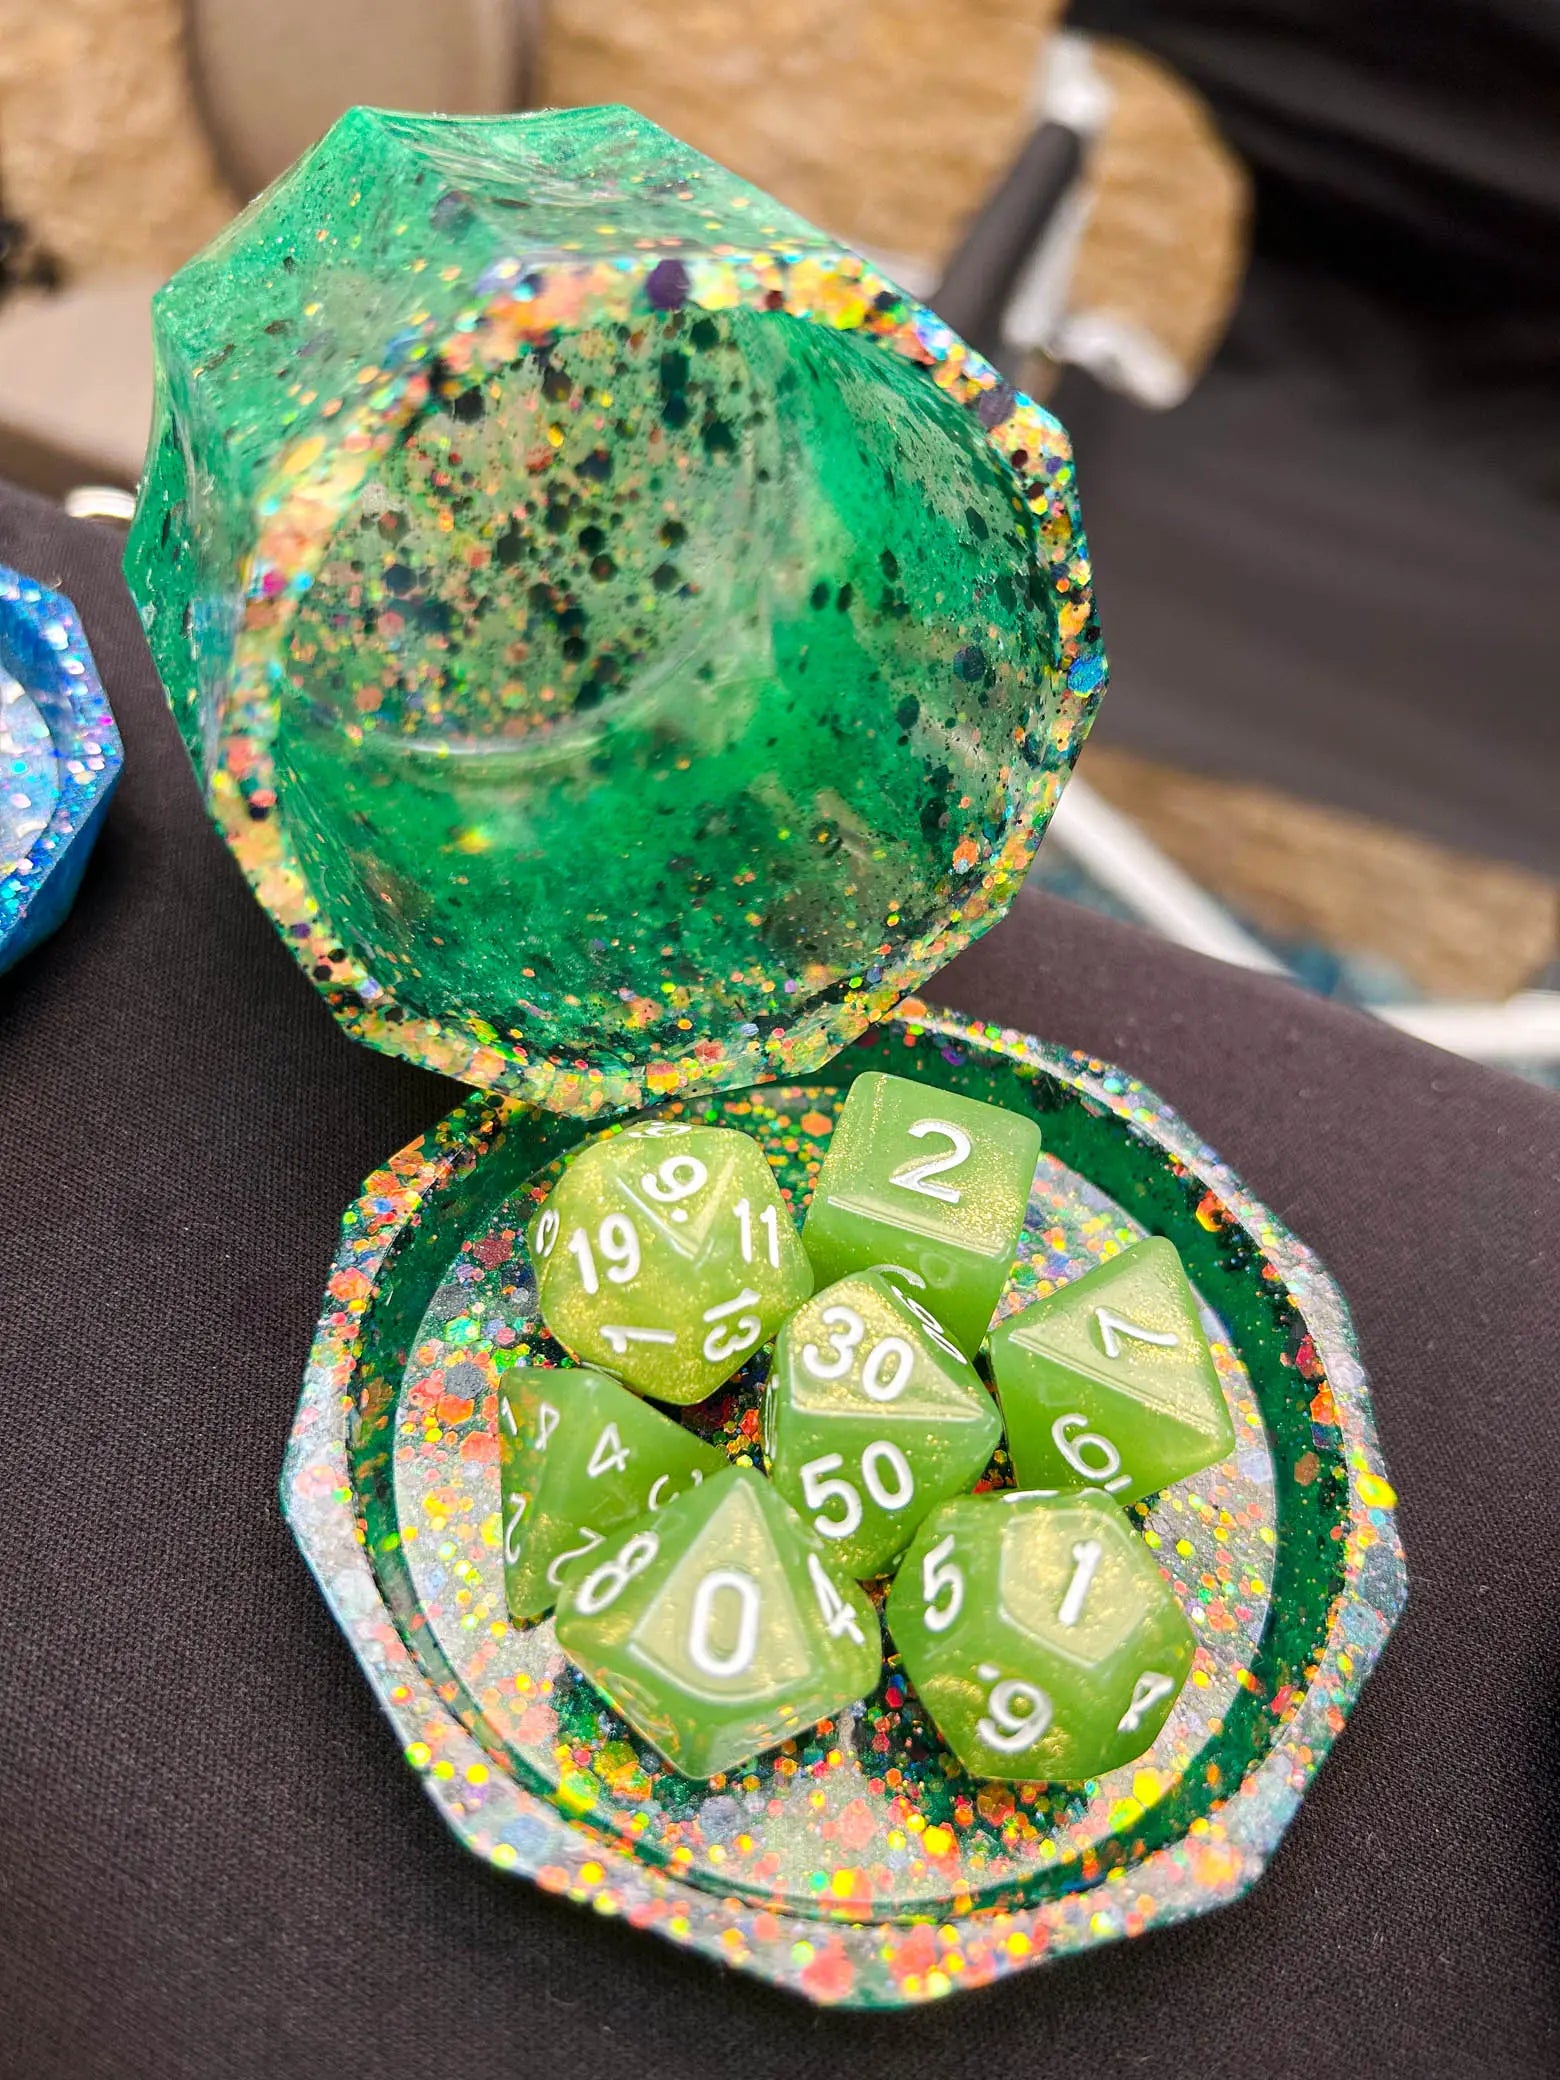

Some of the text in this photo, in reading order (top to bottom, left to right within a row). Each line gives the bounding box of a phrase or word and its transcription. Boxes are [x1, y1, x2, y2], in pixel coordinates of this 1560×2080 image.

[889, 1119, 972, 1204] 2
[568, 1213, 641, 1295] 19
[733, 1198, 780, 1269] 11
[702, 1287, 762, 1363] 13
[802, 1305, 915, 1401] 30
[586, 1422, 631, 1478] 4
[800, 1440, 914, 1539] 50
[574, 1529, 660, 1615] 8
[807, 1552, 867, 1645] 4
[922, 1535, 964, 1633] 5
[1057, 1539, 1103, 1627] 1
[687, 1568, 761, 1678] 0
